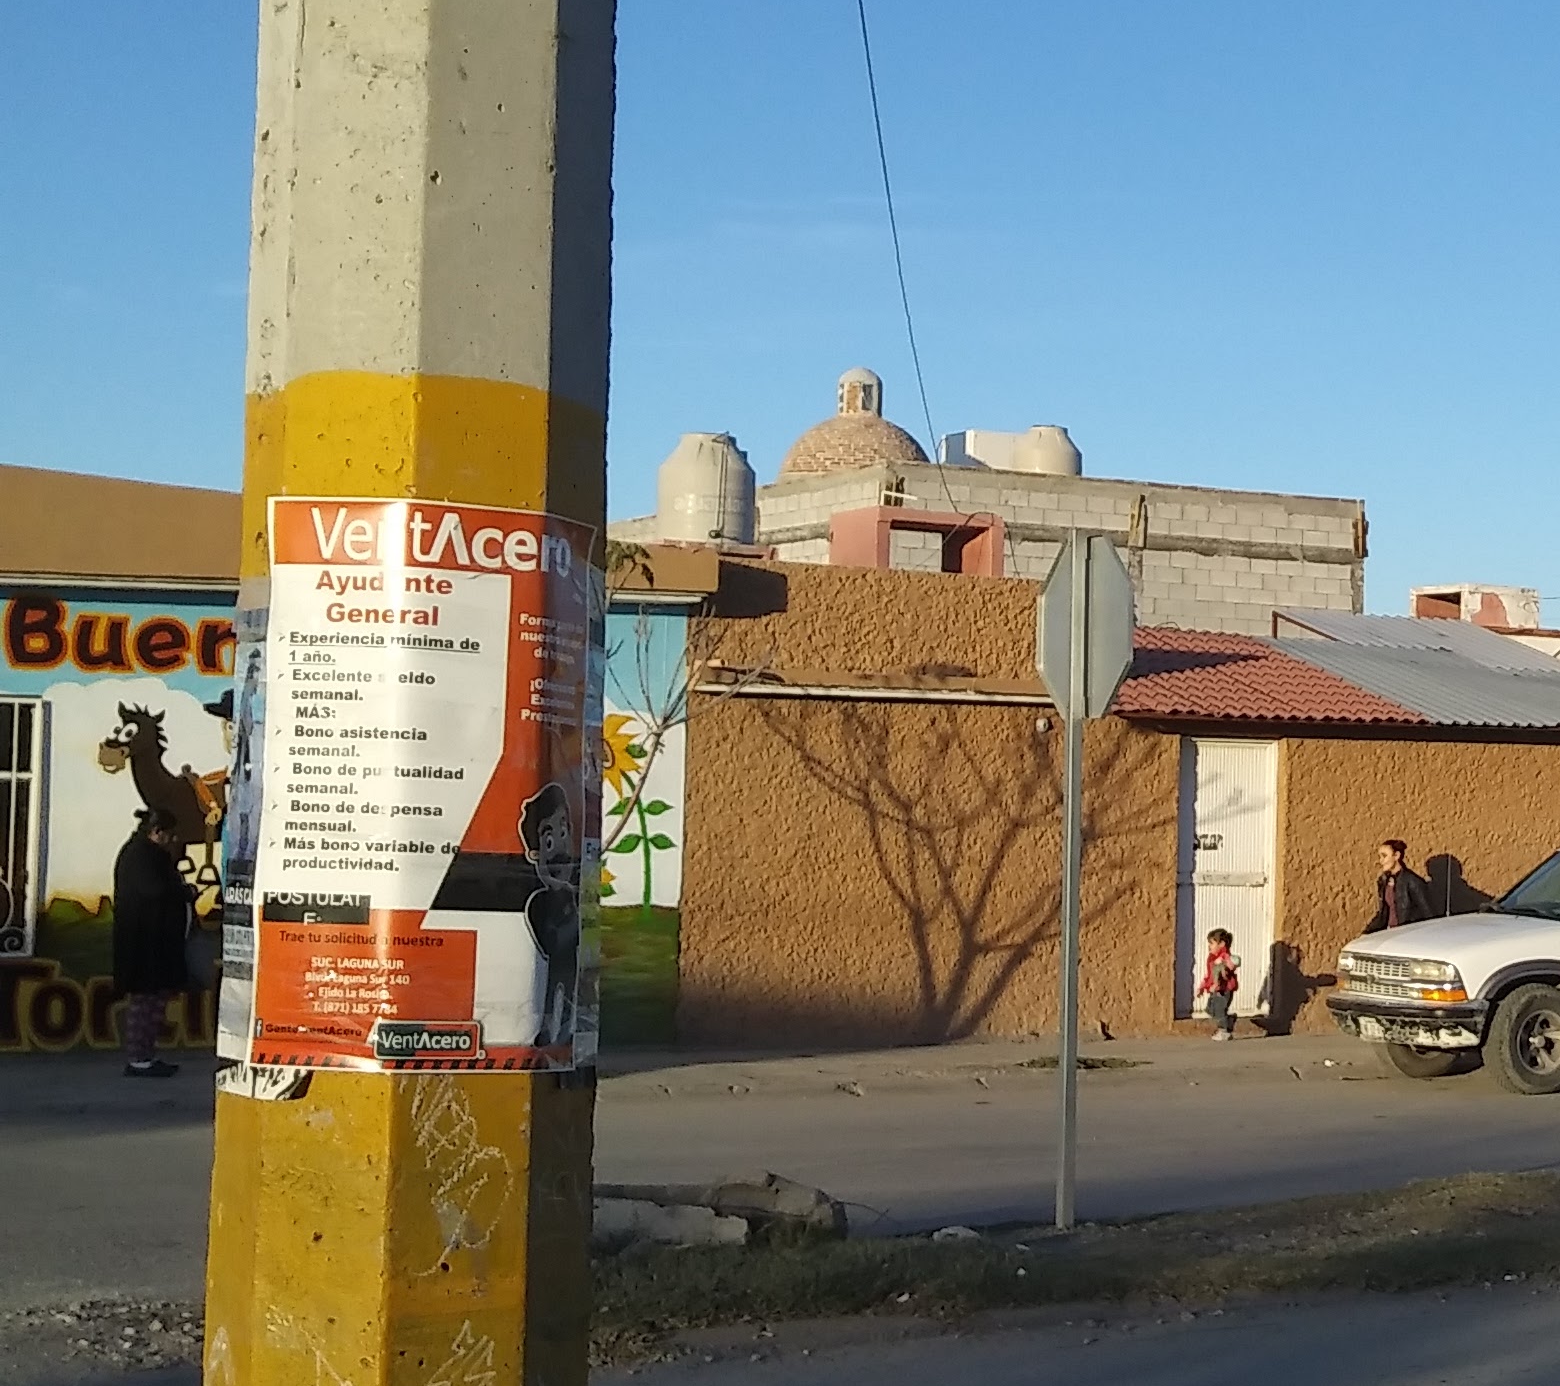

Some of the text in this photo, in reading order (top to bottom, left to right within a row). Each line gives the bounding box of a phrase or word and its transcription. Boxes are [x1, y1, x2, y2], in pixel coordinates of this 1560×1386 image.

[315, 570, 453, 596] Ayudnte
[326, 603, 439, 626] General
[289, 631, 385, 646] Experiencia
[459, 637, 481, 651] de
[289, 650, 337, 663] 1 año.
[292, 669, 436, 685] Excelente seldo
[291, 689, 364, 701] semanal.
[295, 703, 336, 719] MÁS:
[294, 725, 428, 741] Bono asistencia
[288, 745, 361, 757] semanal.
[292, 763, 465, 780] Bono de putualidad
[286, 783, 359, 795] semanal.
[290, 799, 330, 813] Bono
[335, 801, 355, 814] de
[284, 820, 357, 833] mensual.
[283, 837, 461, 855] Más bono variable de
[282, 856, 400, 872] productividad.
[278, 931, 305, 942] Trae
[308, 932, 321, 943] tu
[325, 931, 376, 945] solicitud
[392, 936, 444, 947] nuestra
[337, 958, 379, 969] LAGUNA
[380, 959, 405, 970] SUR
[381, 1031, 471, 1049] VentAcero
